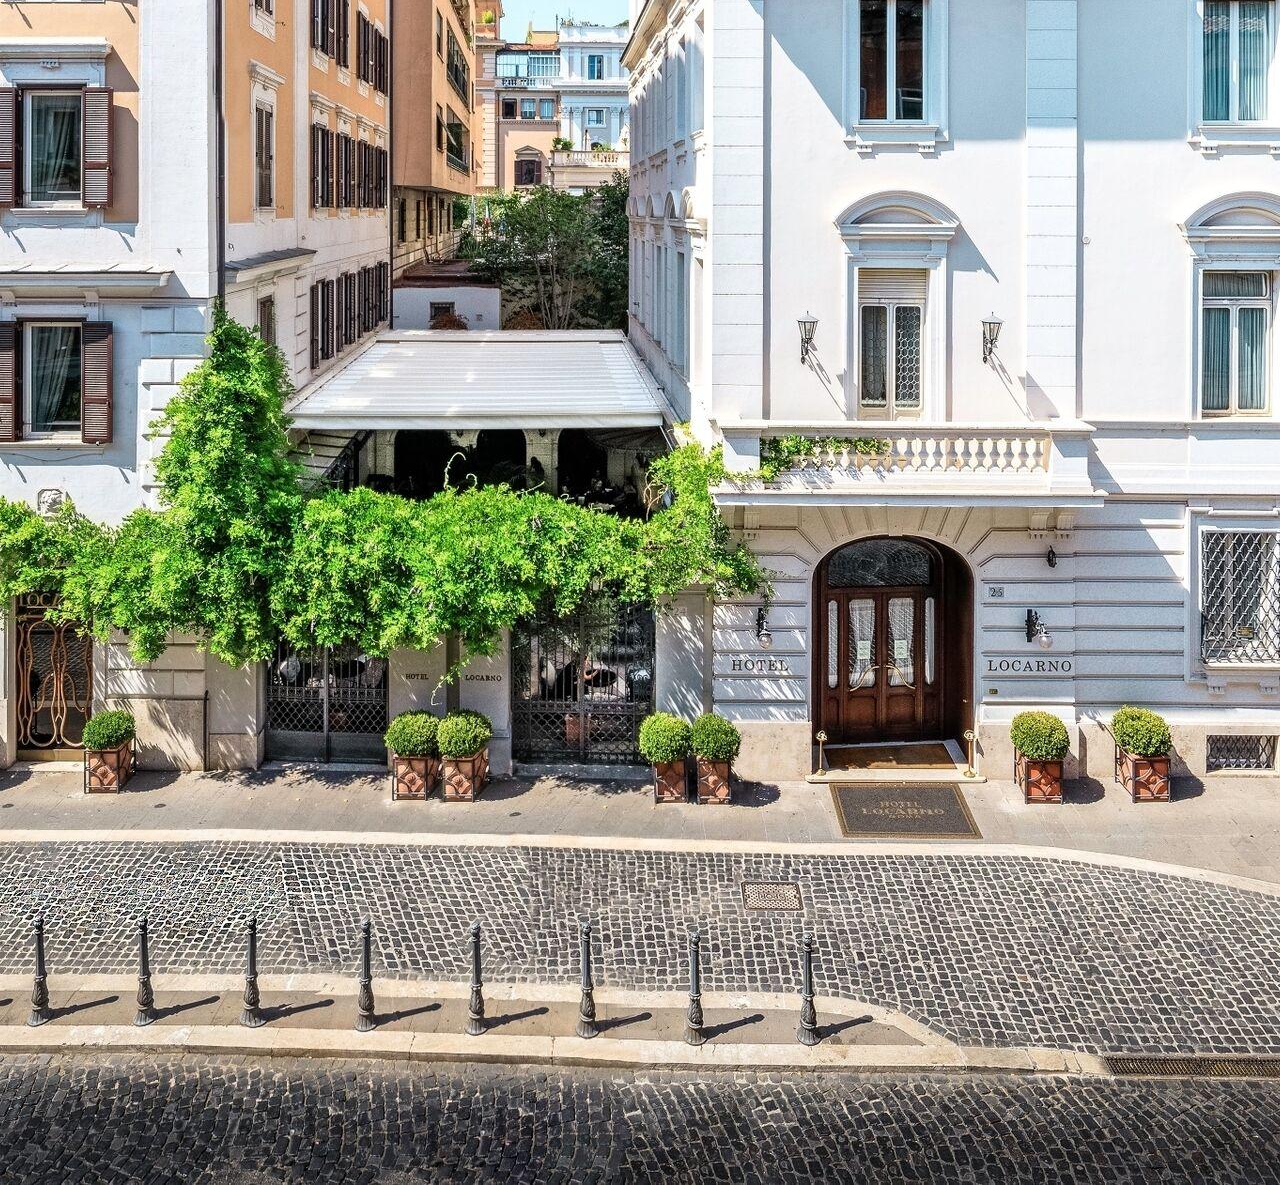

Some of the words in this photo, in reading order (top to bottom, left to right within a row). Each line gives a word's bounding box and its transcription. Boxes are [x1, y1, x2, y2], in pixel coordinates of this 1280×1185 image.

[990, 587, 1004, 598] 25
[731, 659, 790, 672] HOTEL
[987, 659, 1073, 672] LOCARNO
[465, 674, 503, 682] LOCARNO
[880, 800, 922, 809] HOTEL
